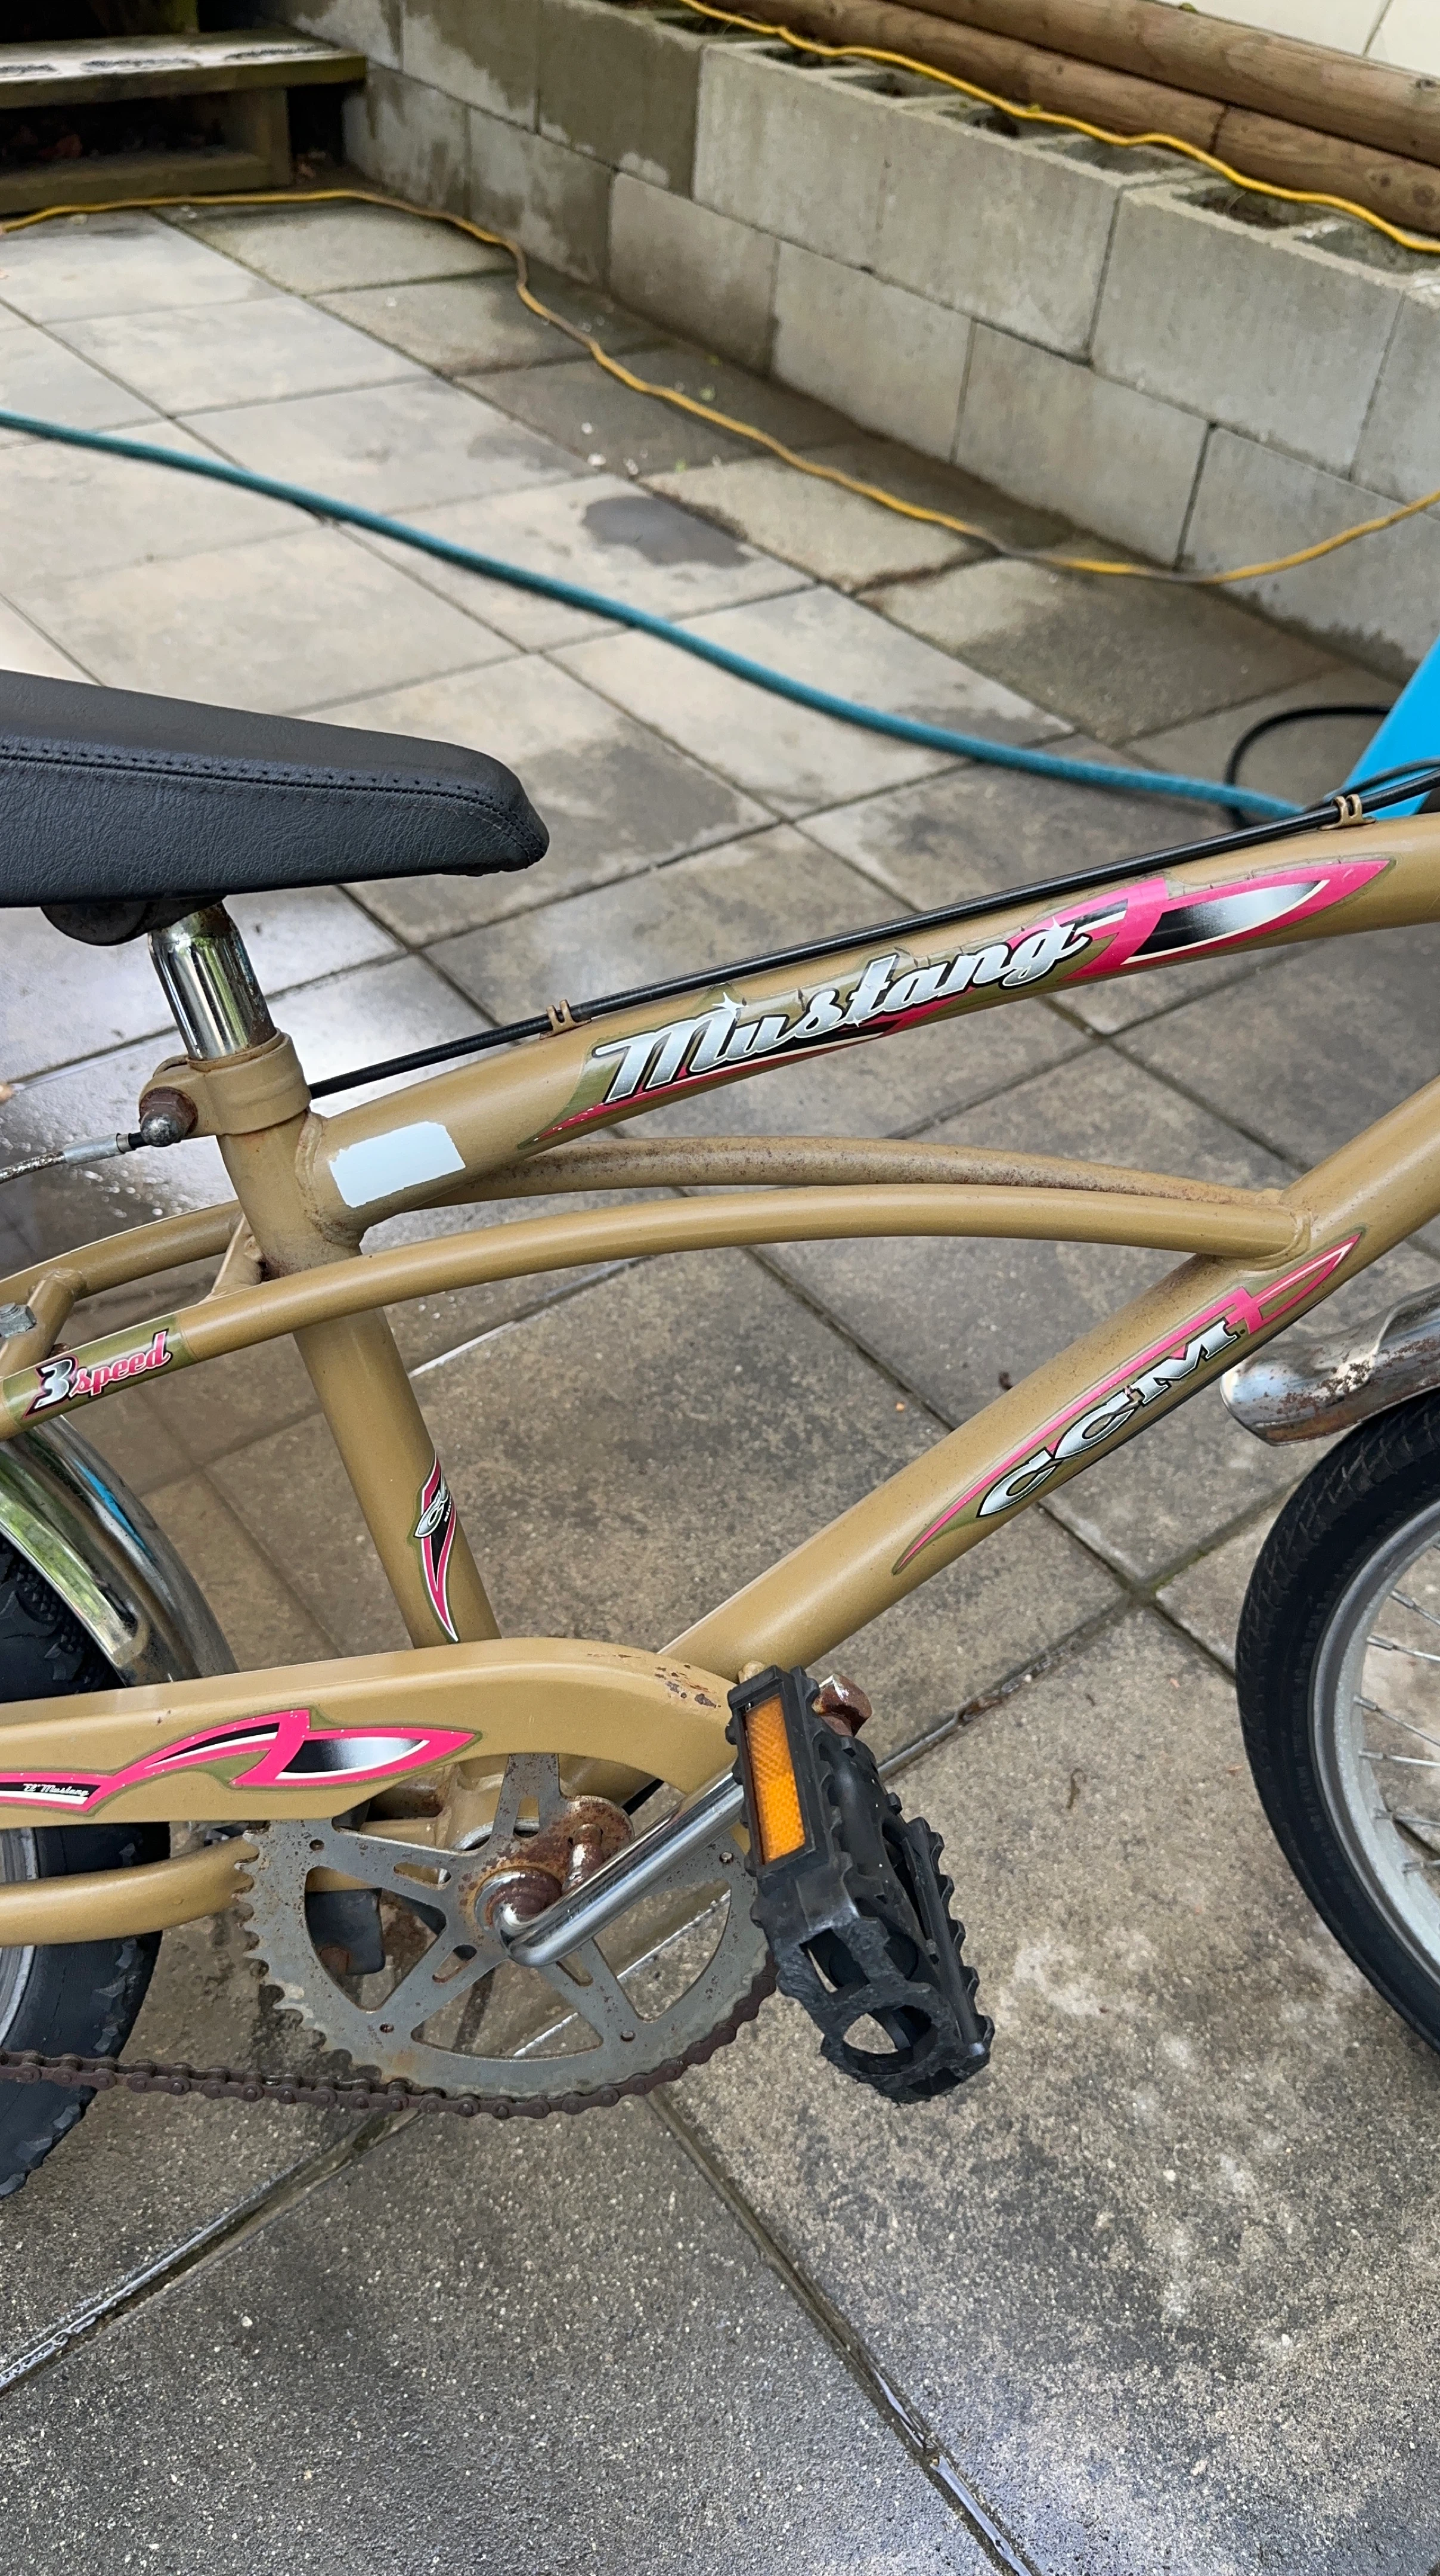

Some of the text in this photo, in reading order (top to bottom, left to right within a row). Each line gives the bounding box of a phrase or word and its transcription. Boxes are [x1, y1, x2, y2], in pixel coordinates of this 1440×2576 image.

[594, 921, 1091, 1103] Mustang
[977, 1318, 1241, 1518] CCM
[41, 1784, 89, 1797] Mustang
